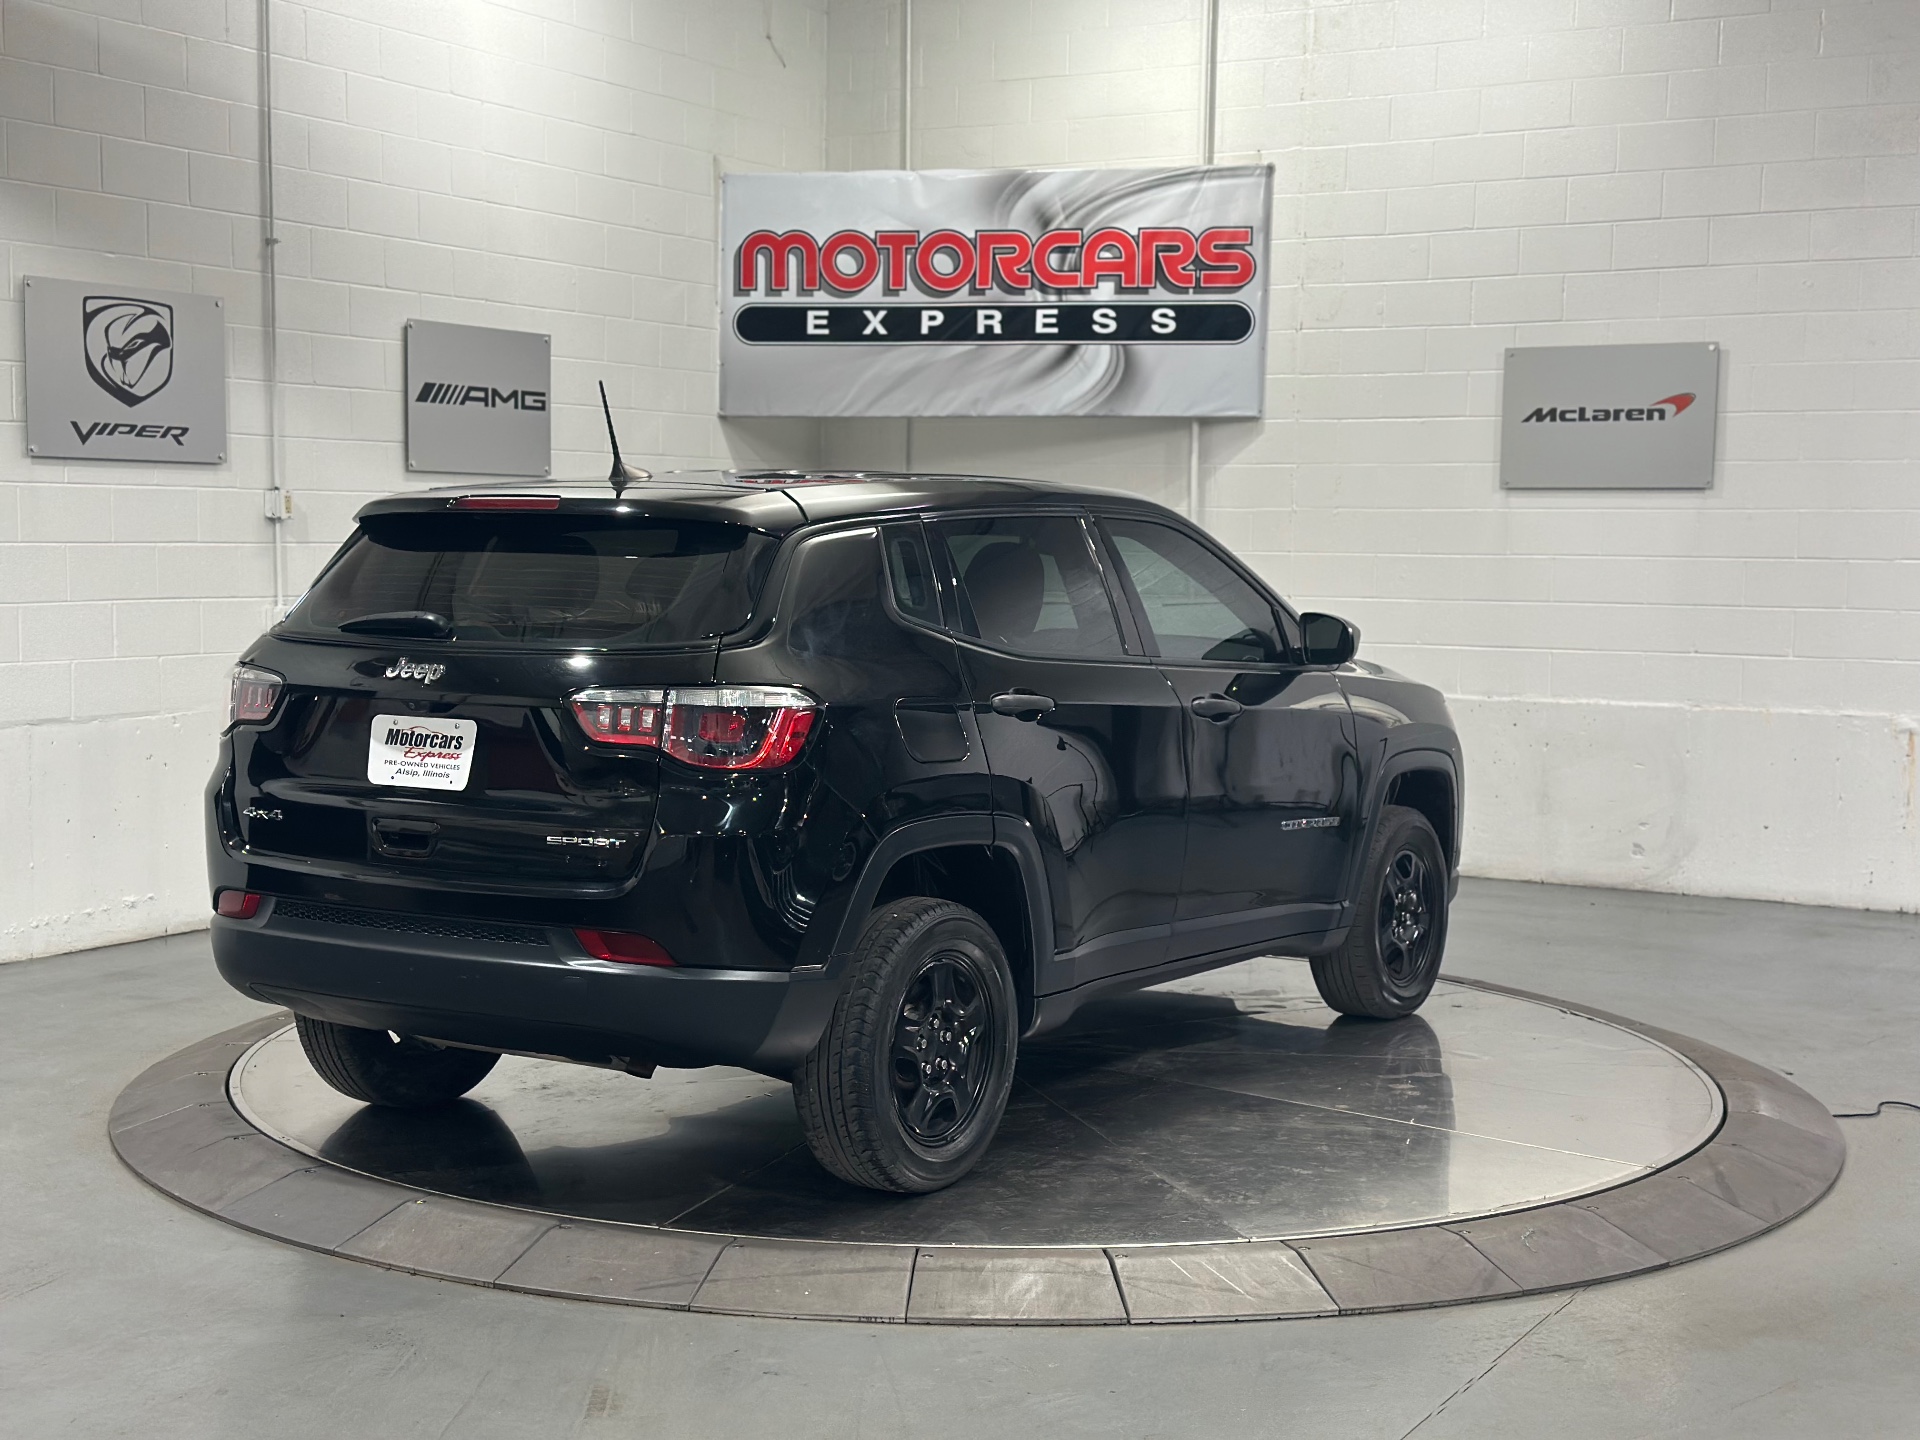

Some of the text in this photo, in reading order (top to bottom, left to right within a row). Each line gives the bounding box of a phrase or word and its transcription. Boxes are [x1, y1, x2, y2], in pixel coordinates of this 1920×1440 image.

[734, 226, 1257, 297] MOTORCARS
[806, 308, 1178, 335] EXPRESS
[459, 385, 546, 412] AMG
[1521, 406, 1666, 423] McLaren
[70, 420, 189, 446] VIPER
[385, 656, 446, 684] Jeep
[385, 728, 464, 750] Motorcars
[384, 759, 429, 768] PRE-OWNED
[404, 746, 462, 761] Express
[422, 770, 450, 779] Illinois
[546, 836, 626, 849] SPORT
